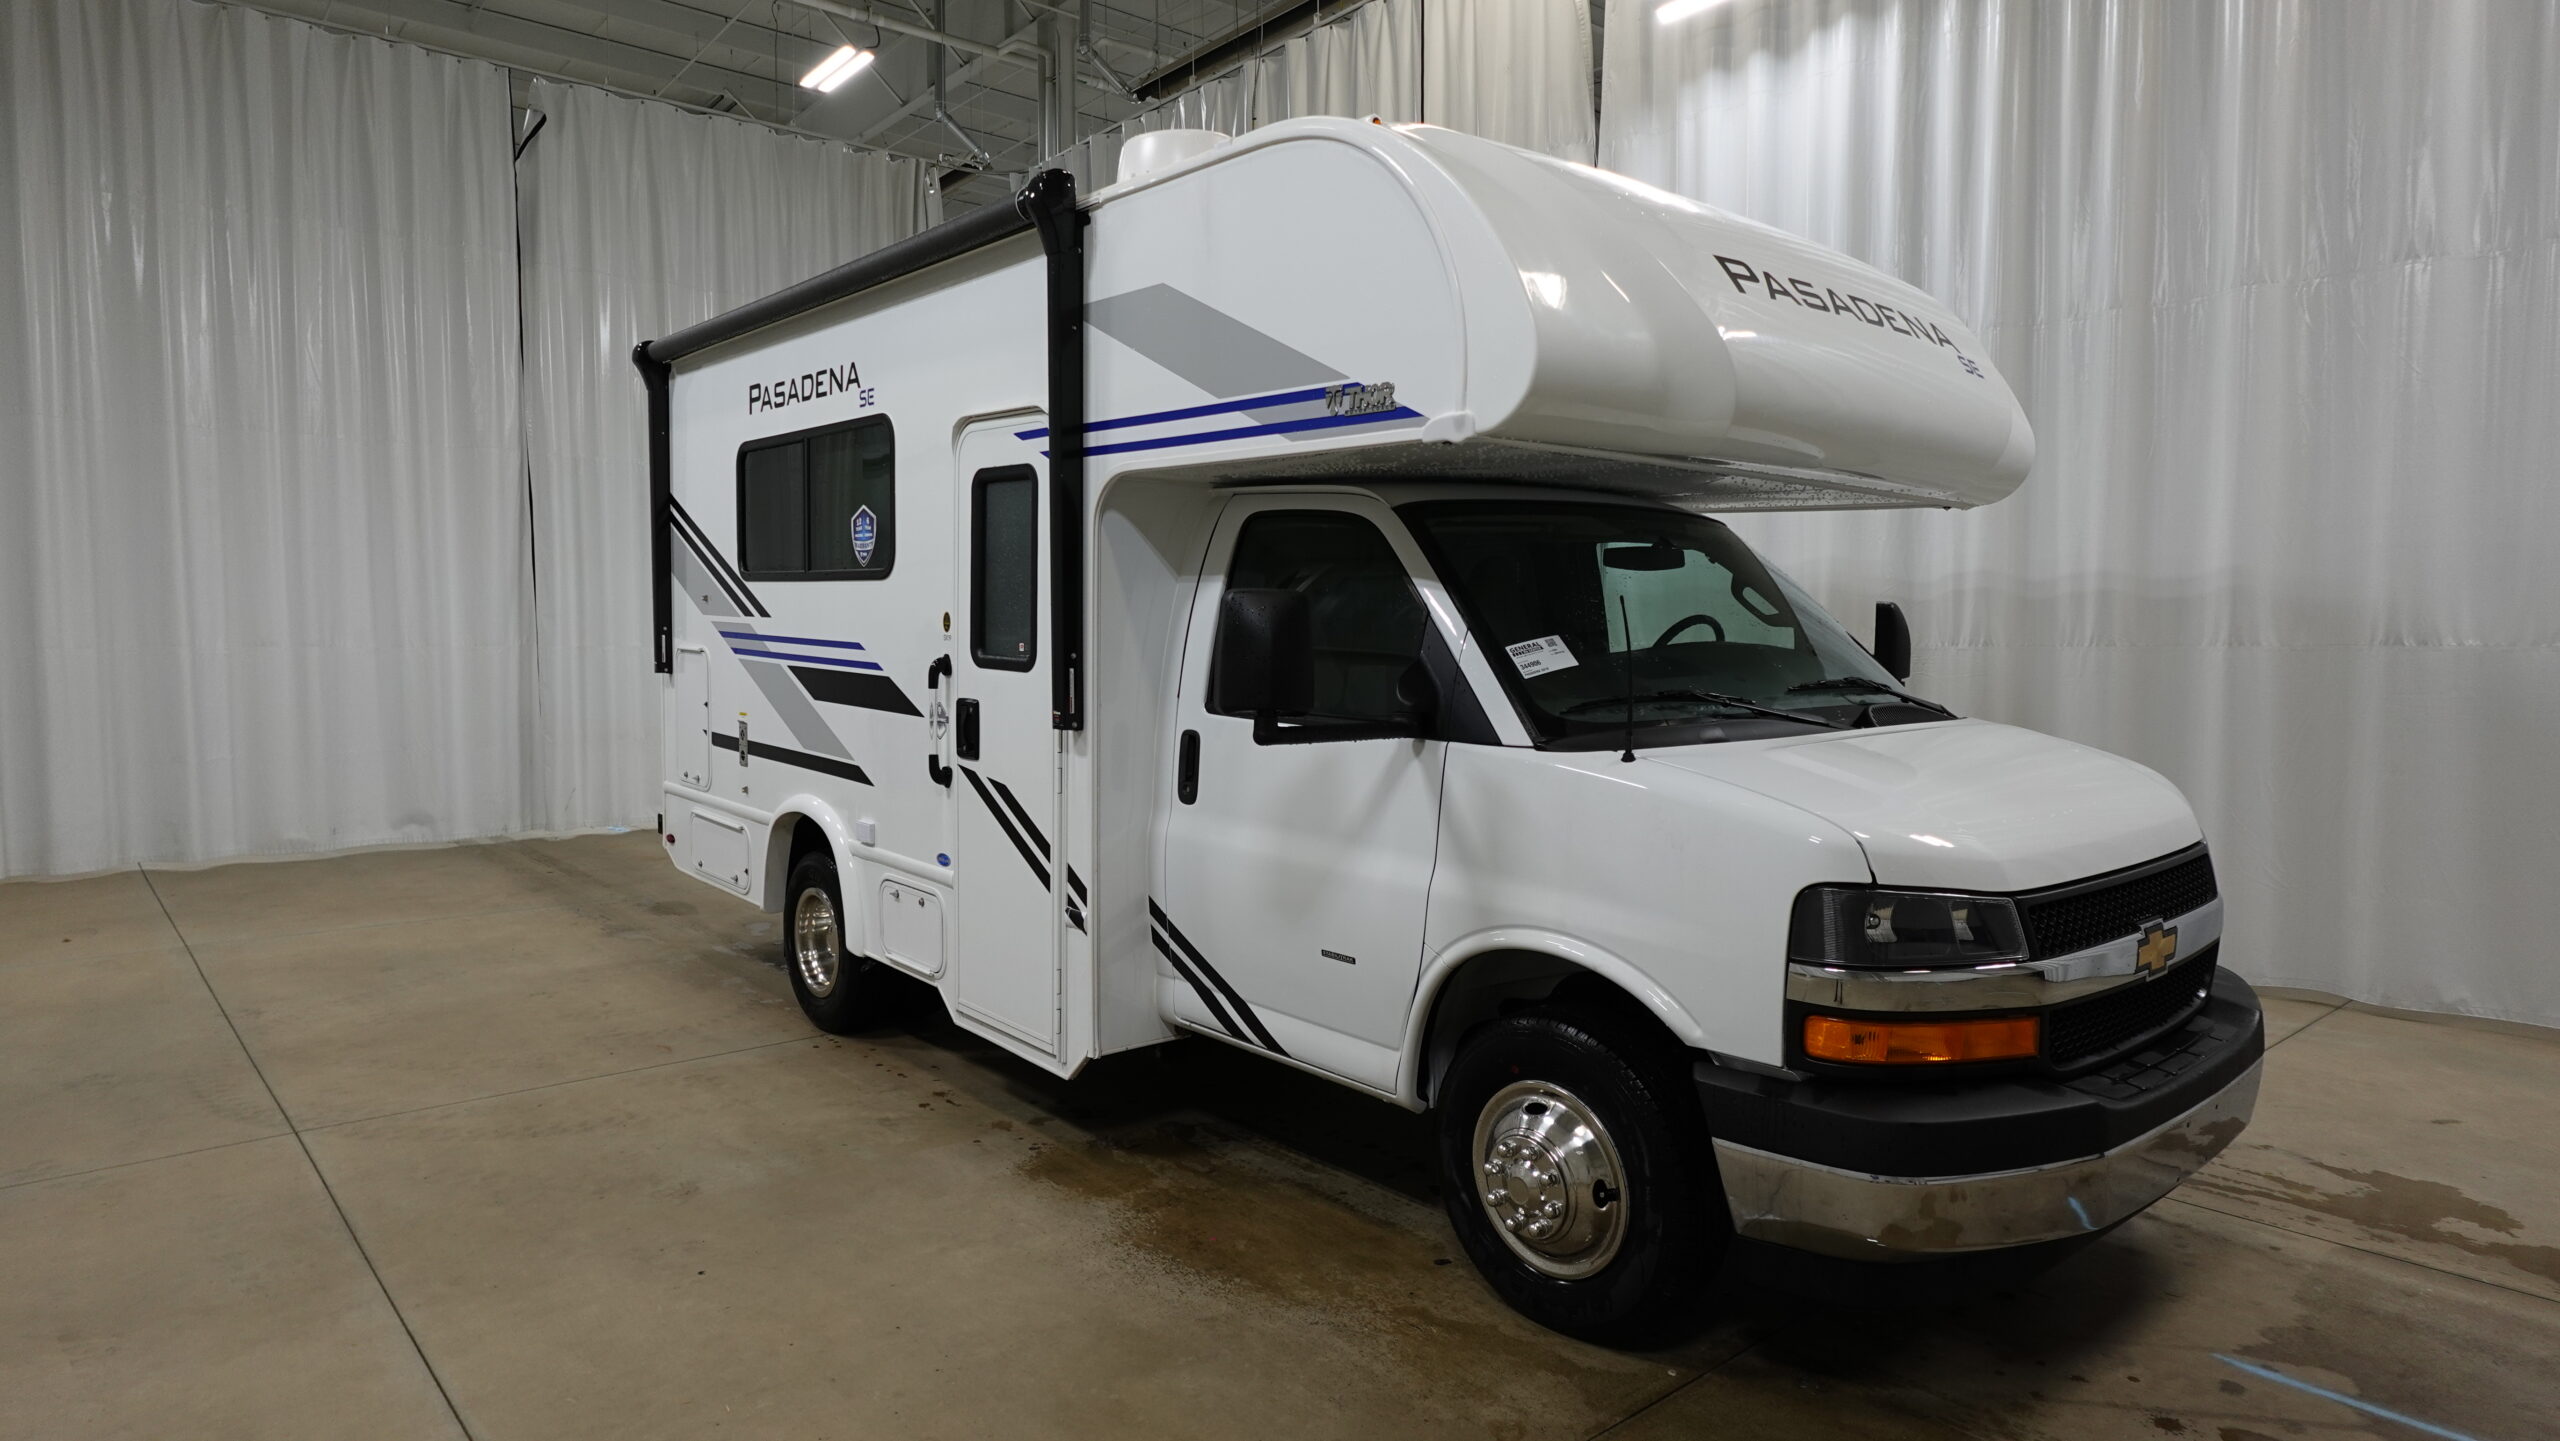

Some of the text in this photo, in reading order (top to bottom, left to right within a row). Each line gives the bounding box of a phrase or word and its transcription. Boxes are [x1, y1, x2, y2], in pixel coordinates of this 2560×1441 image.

[1713, 254, 1962, 354] PASADENA
[1957, 355, 1985, 379] SE
[749, 361, 861, 415] PASADENA
[859, 388, 875, 408] SE
[1343, 382, 1396, 411] THOR
[1509, 641, 1542, 654] GENERAL
